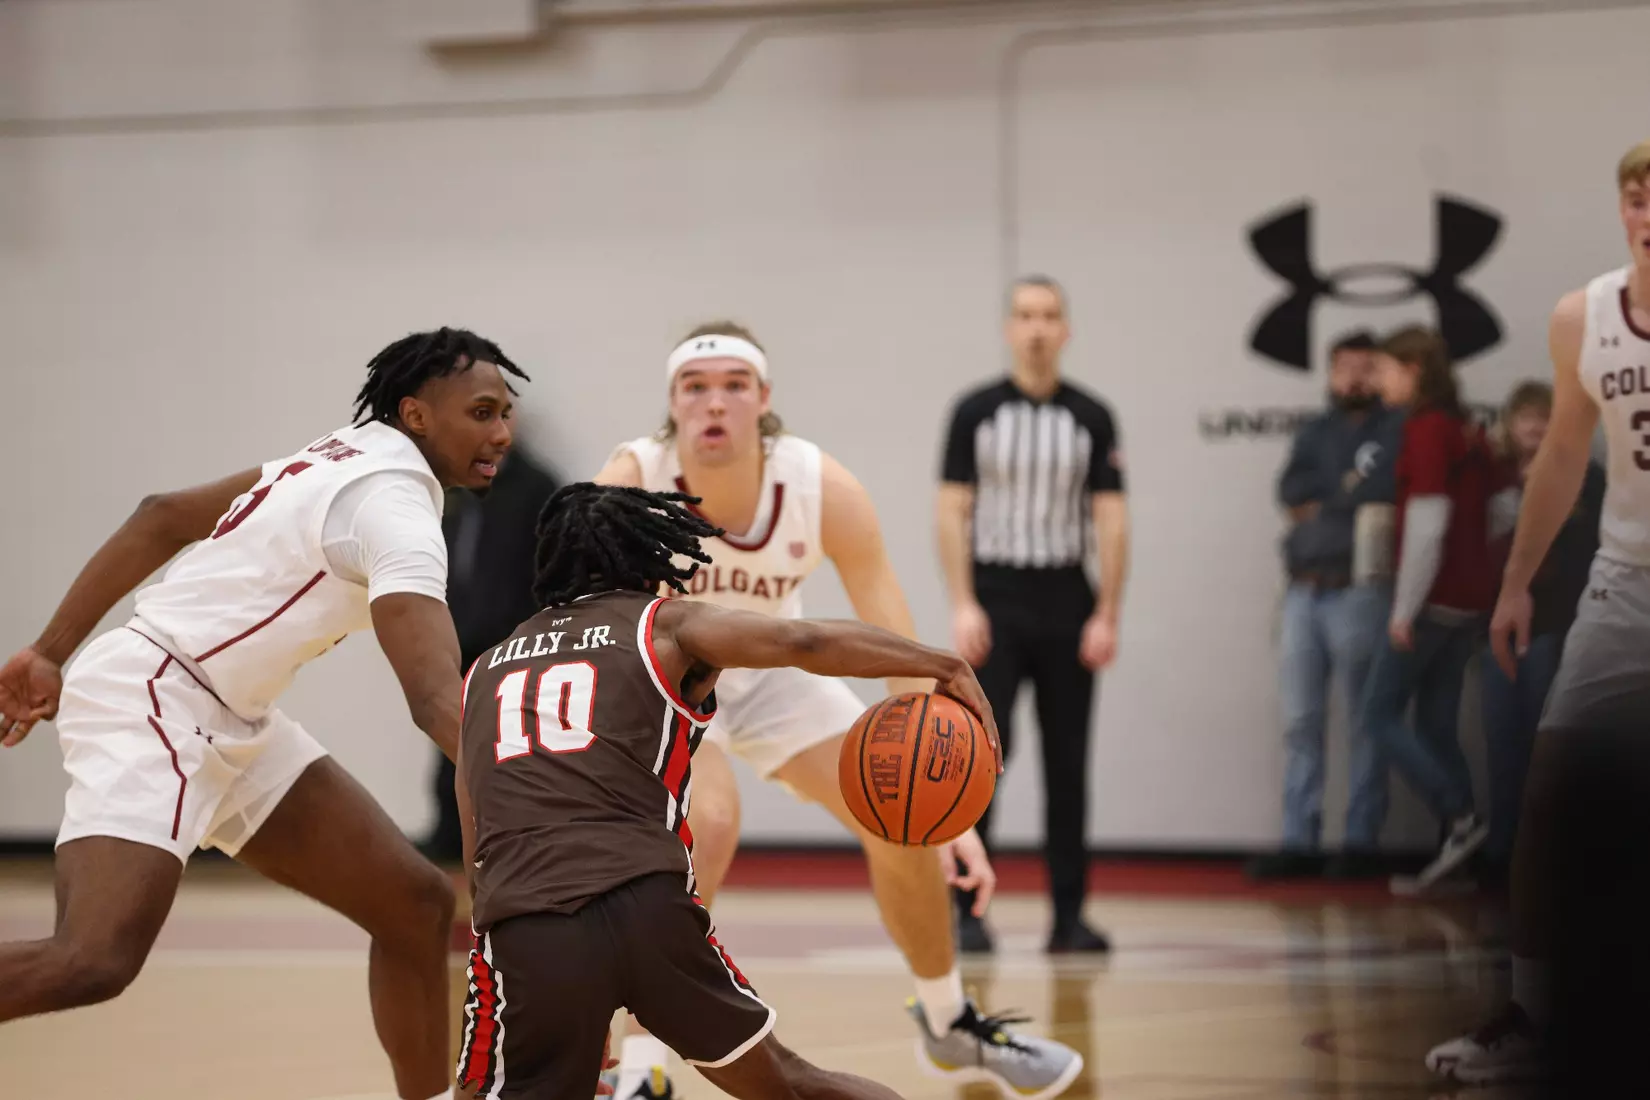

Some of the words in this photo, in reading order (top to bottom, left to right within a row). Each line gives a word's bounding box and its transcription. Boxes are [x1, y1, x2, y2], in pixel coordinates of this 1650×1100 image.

[488, 631, 567, 670] LILLY
[573, 625, 616, 650] JR.
[493, 660, 598, 764] 10
[869, 753, 902, 804] THE
